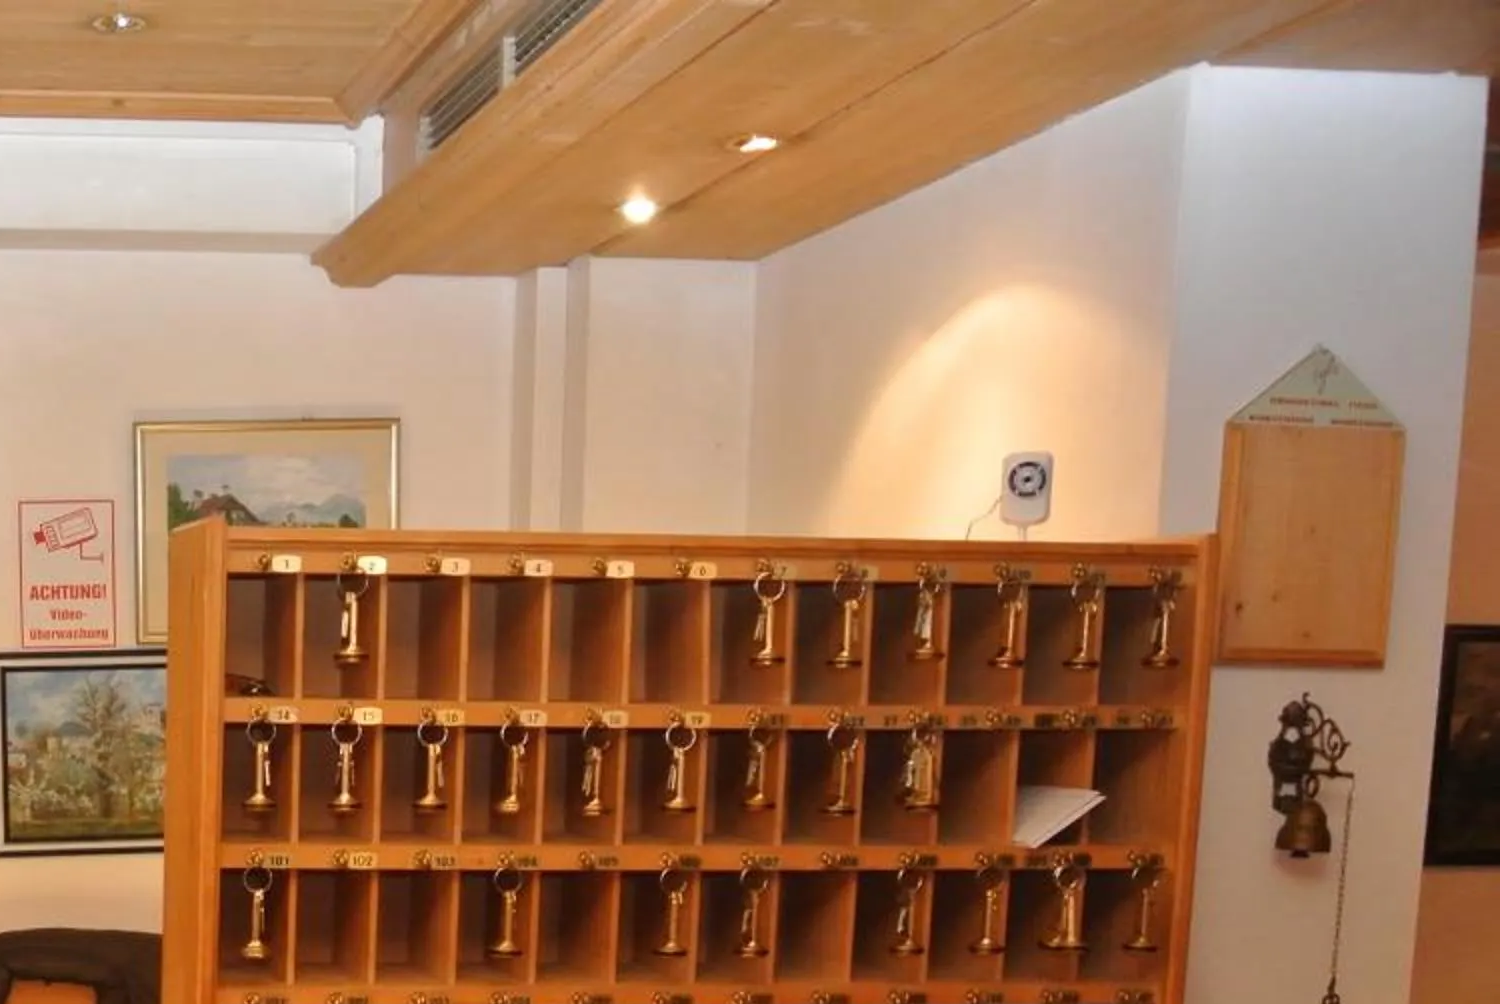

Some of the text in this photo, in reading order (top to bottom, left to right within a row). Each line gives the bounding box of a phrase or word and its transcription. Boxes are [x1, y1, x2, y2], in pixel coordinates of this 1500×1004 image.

[29, 584, 107, 601] ACHTUNG!
[49, 608, 88, 621] Video-
[269, 856, 289, 866] 101
[352, 856, 373, 867] 102
